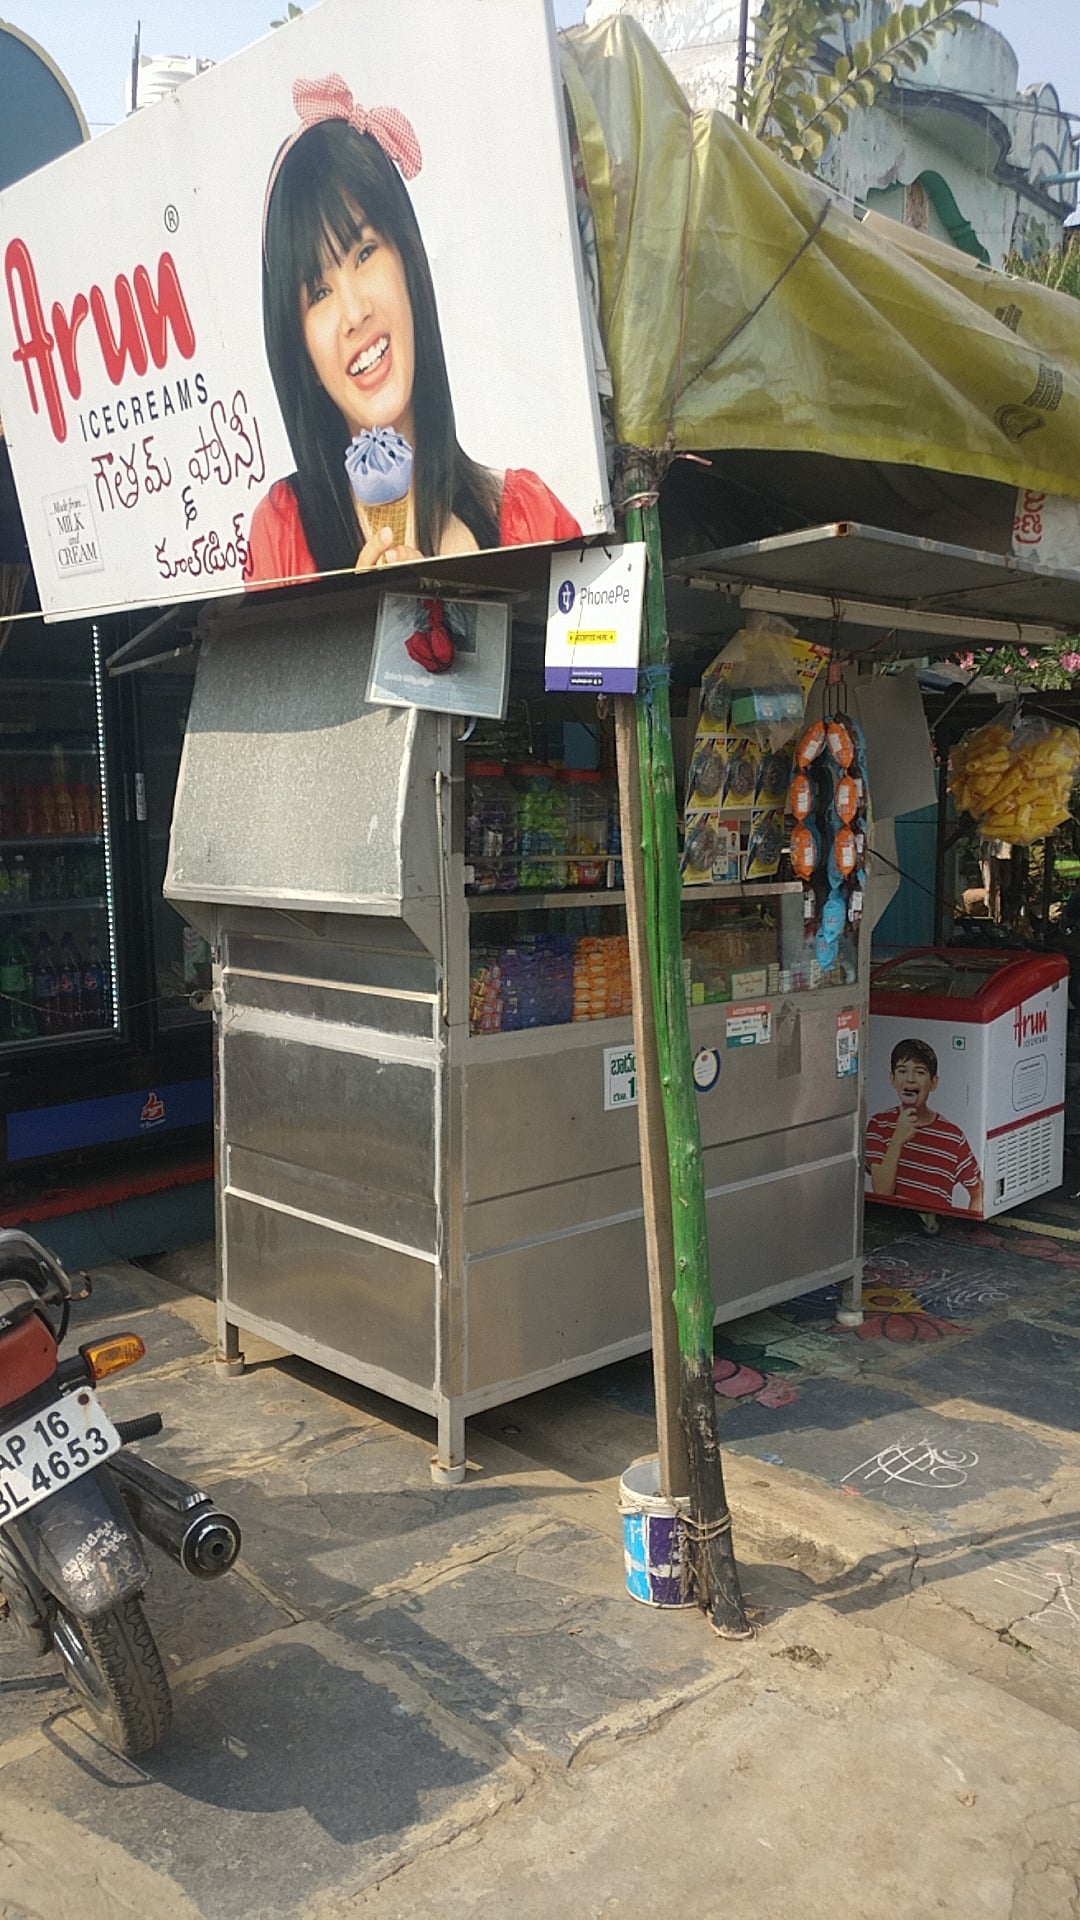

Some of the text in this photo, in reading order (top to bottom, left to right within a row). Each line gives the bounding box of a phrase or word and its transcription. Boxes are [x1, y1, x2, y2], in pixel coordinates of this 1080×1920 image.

[4, 237, 196, 443] Arun
[79, 372, 209, 442] ICECREAMS
[56, 512, 85, 535] MILK
[68, 532, 80, 545] and
[58, 541, 98, 566] CREAM
[580, 585, 630, 605] PhonePe
[33, 1411, 70, 1447] 16
[31, 1427, 109, 1492] 4653
